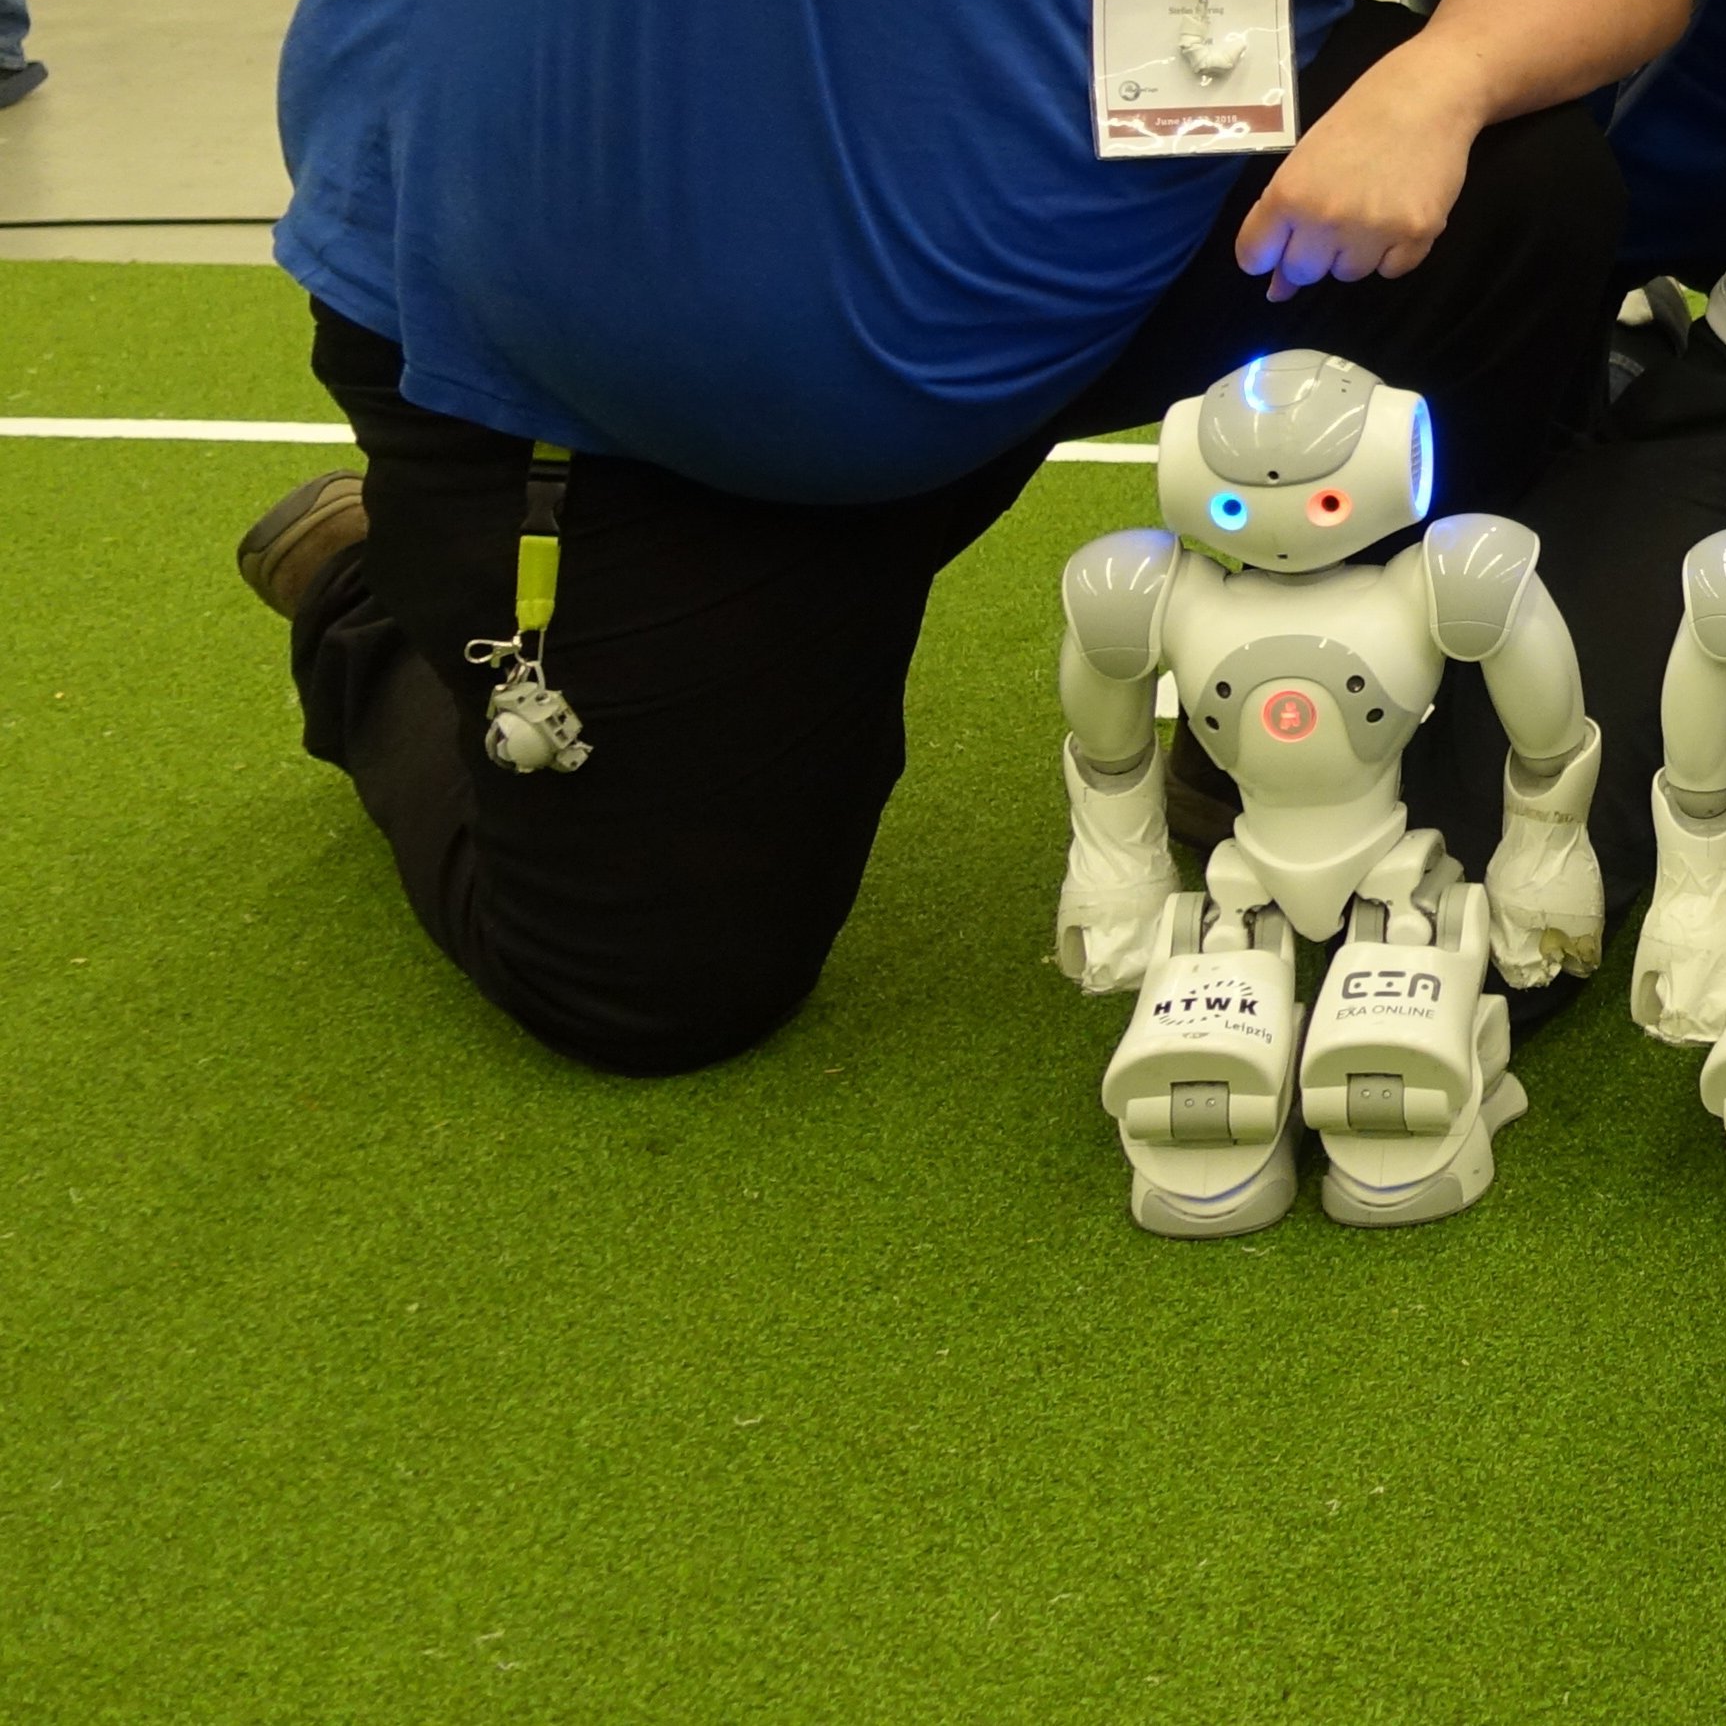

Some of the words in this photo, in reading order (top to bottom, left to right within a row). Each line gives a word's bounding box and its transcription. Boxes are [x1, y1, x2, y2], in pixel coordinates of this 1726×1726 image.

[1153, 994, 1259, 1017] HTWK
[1335, 1007, 1367, 1021] EXA
[1372, 1004, 1435, 1020] ONLINE
[1224, 1019, 1272, 1044] Leipzig
